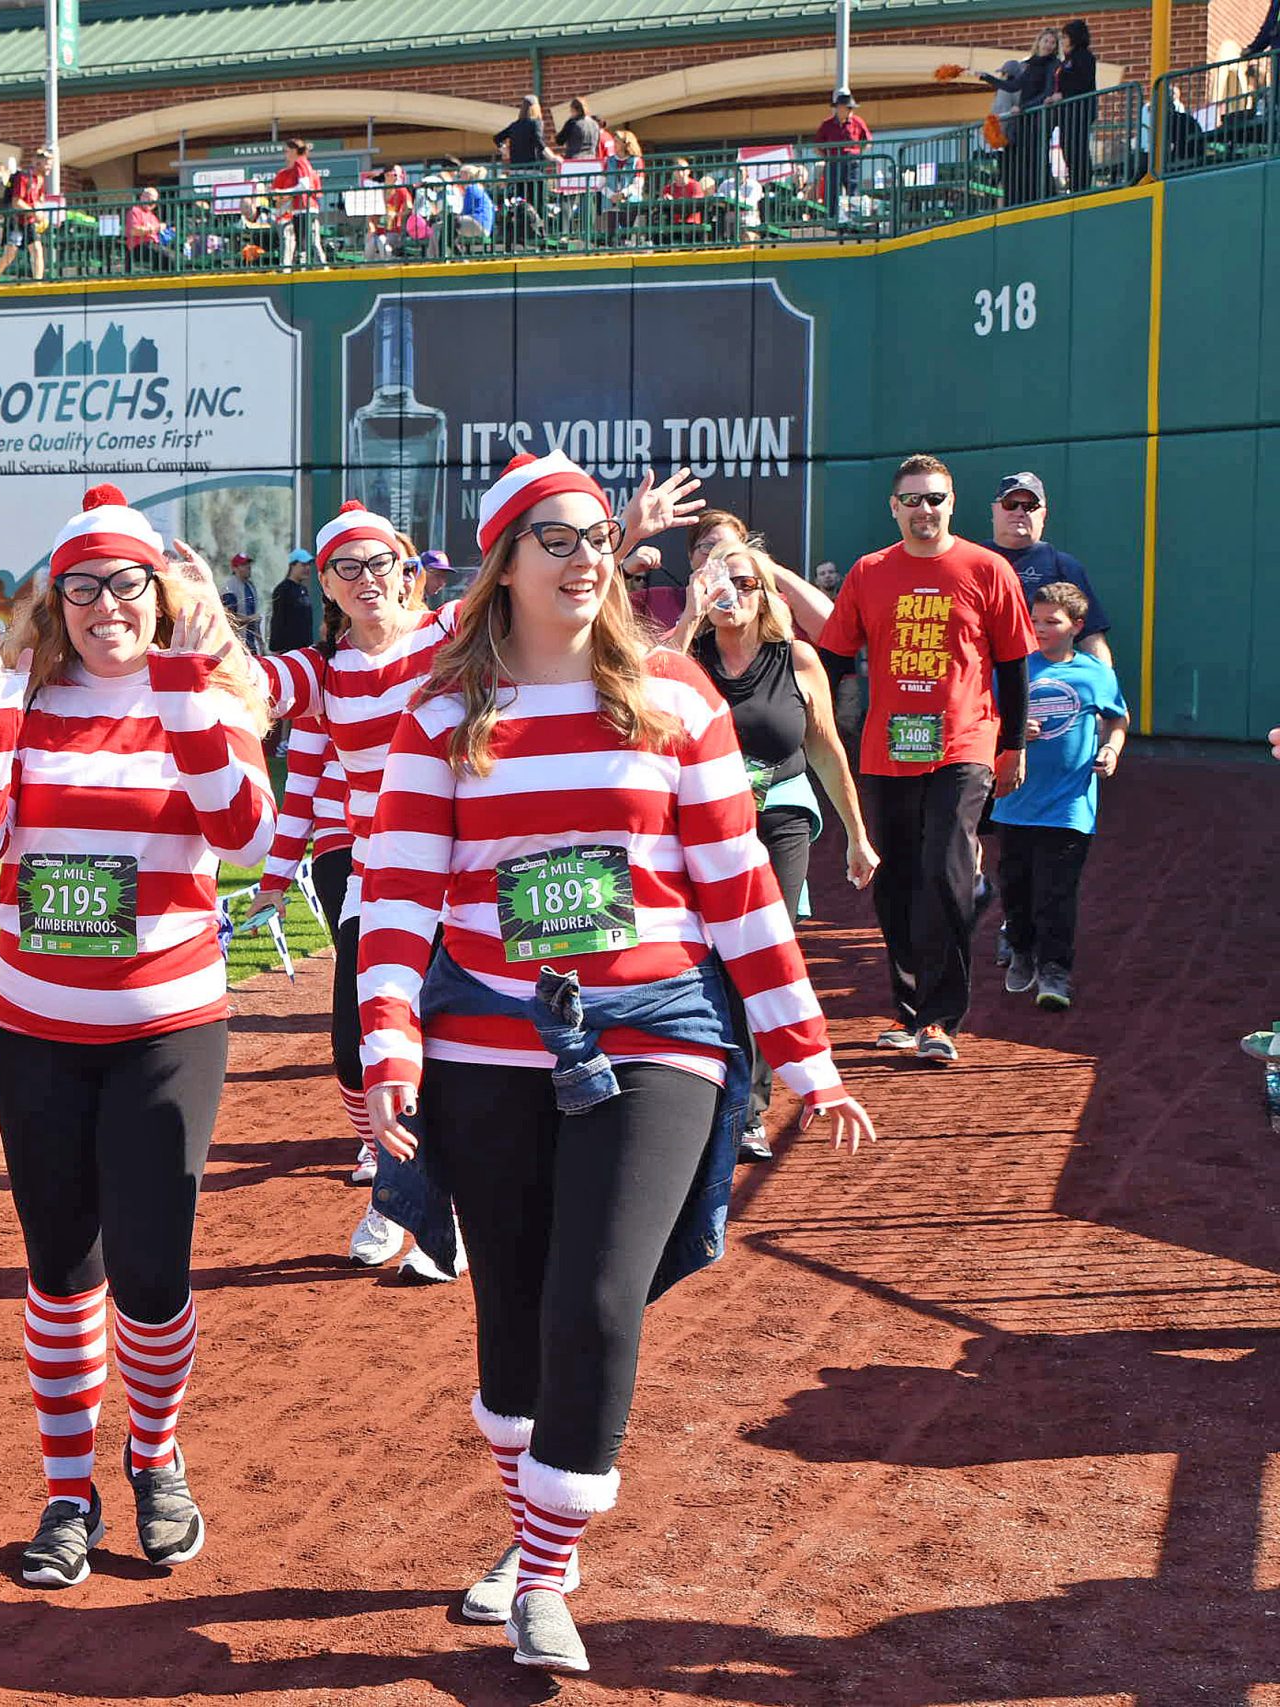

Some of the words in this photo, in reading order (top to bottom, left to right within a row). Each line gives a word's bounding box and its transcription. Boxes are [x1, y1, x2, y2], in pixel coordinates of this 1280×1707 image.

[233, 145, 283, 155] PARKVIEW
[974, 282, 1036, 336] 318
[185, 386, 245, 419] INC.
[28, 433, 93, 456] Quality
[97, 431, 156, 450] Comes
[161, 429, 213, 449] First"
[461, 421, 533, 481] IT'S
[542, 418, 652, 479] YOUR
[663, 416, 790, 478] TOWN
[20, 459, 65, 474] Service
[69, 458, 144, 474] Restoration
[147, 457, 212, 476] Company
[896, 594, 953, 621] RUN
[896, 622, 946, 649] THE
[890, 650, 953, 679] FORT
[898, 728, 930, 742] 1408
[52, 869, 60, 880] 4
[63, 868, 96, 882] MILE
[537, 868, 546, 879] 4
[550, 862, 586, 877] MILE
[41, 884, 107, 916] 2195
[525, 877, 603, 916] 1893
[34, 916, 118, 933] KIMBERLYROOS
[542, 914, 593, 933] ANDREA
[611, 930, 622, 943] P
[112, 944, 120, 954] P
